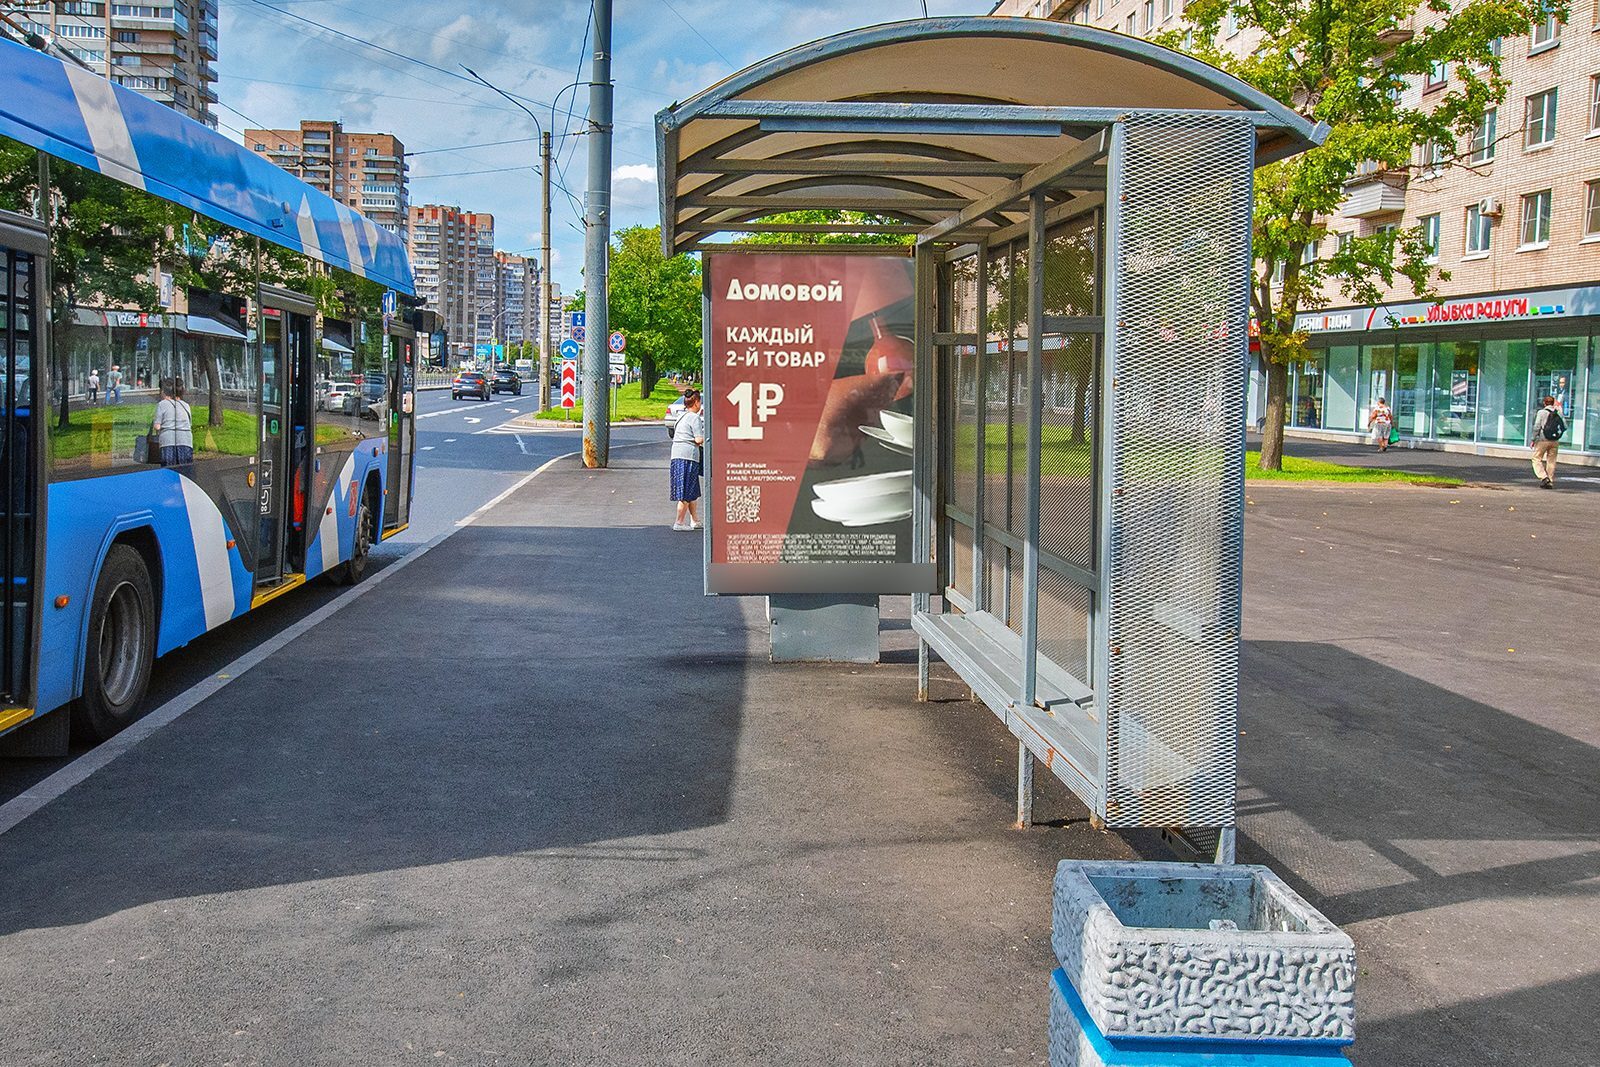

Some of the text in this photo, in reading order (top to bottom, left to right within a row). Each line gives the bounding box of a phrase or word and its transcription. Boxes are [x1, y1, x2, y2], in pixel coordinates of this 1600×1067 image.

[726, 324, 813, 346] КАЖДЫЙ
[726, 347, 826, 368] 2-Й ТОВАР
